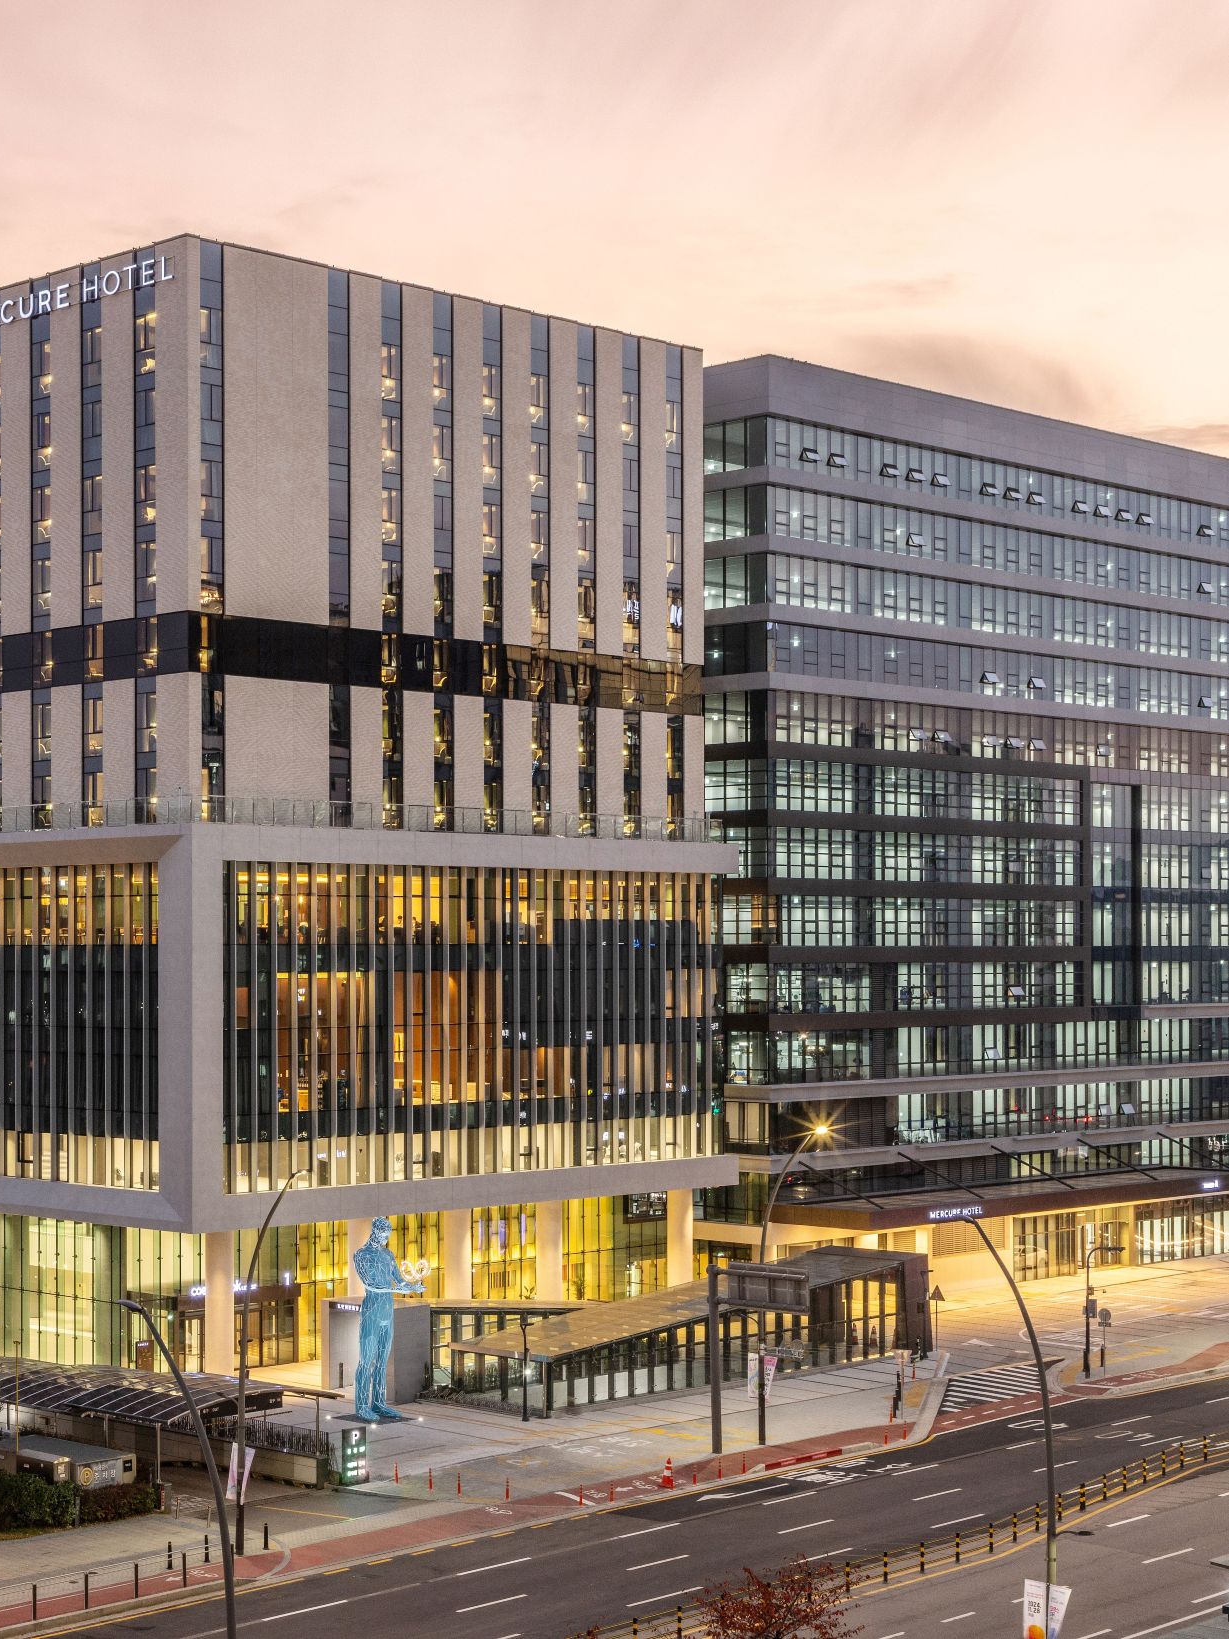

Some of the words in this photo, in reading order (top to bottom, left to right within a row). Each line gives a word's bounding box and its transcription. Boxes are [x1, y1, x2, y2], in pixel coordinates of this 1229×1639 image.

[83, 256, 173, 302] HOTEL
[929, 1209, 961, 1219] MERCURE
[962, 1207, 983, 1216] HOTEL
[284, 1272, 290, 1286] 1
[352, 1431, 360, 1445] P
